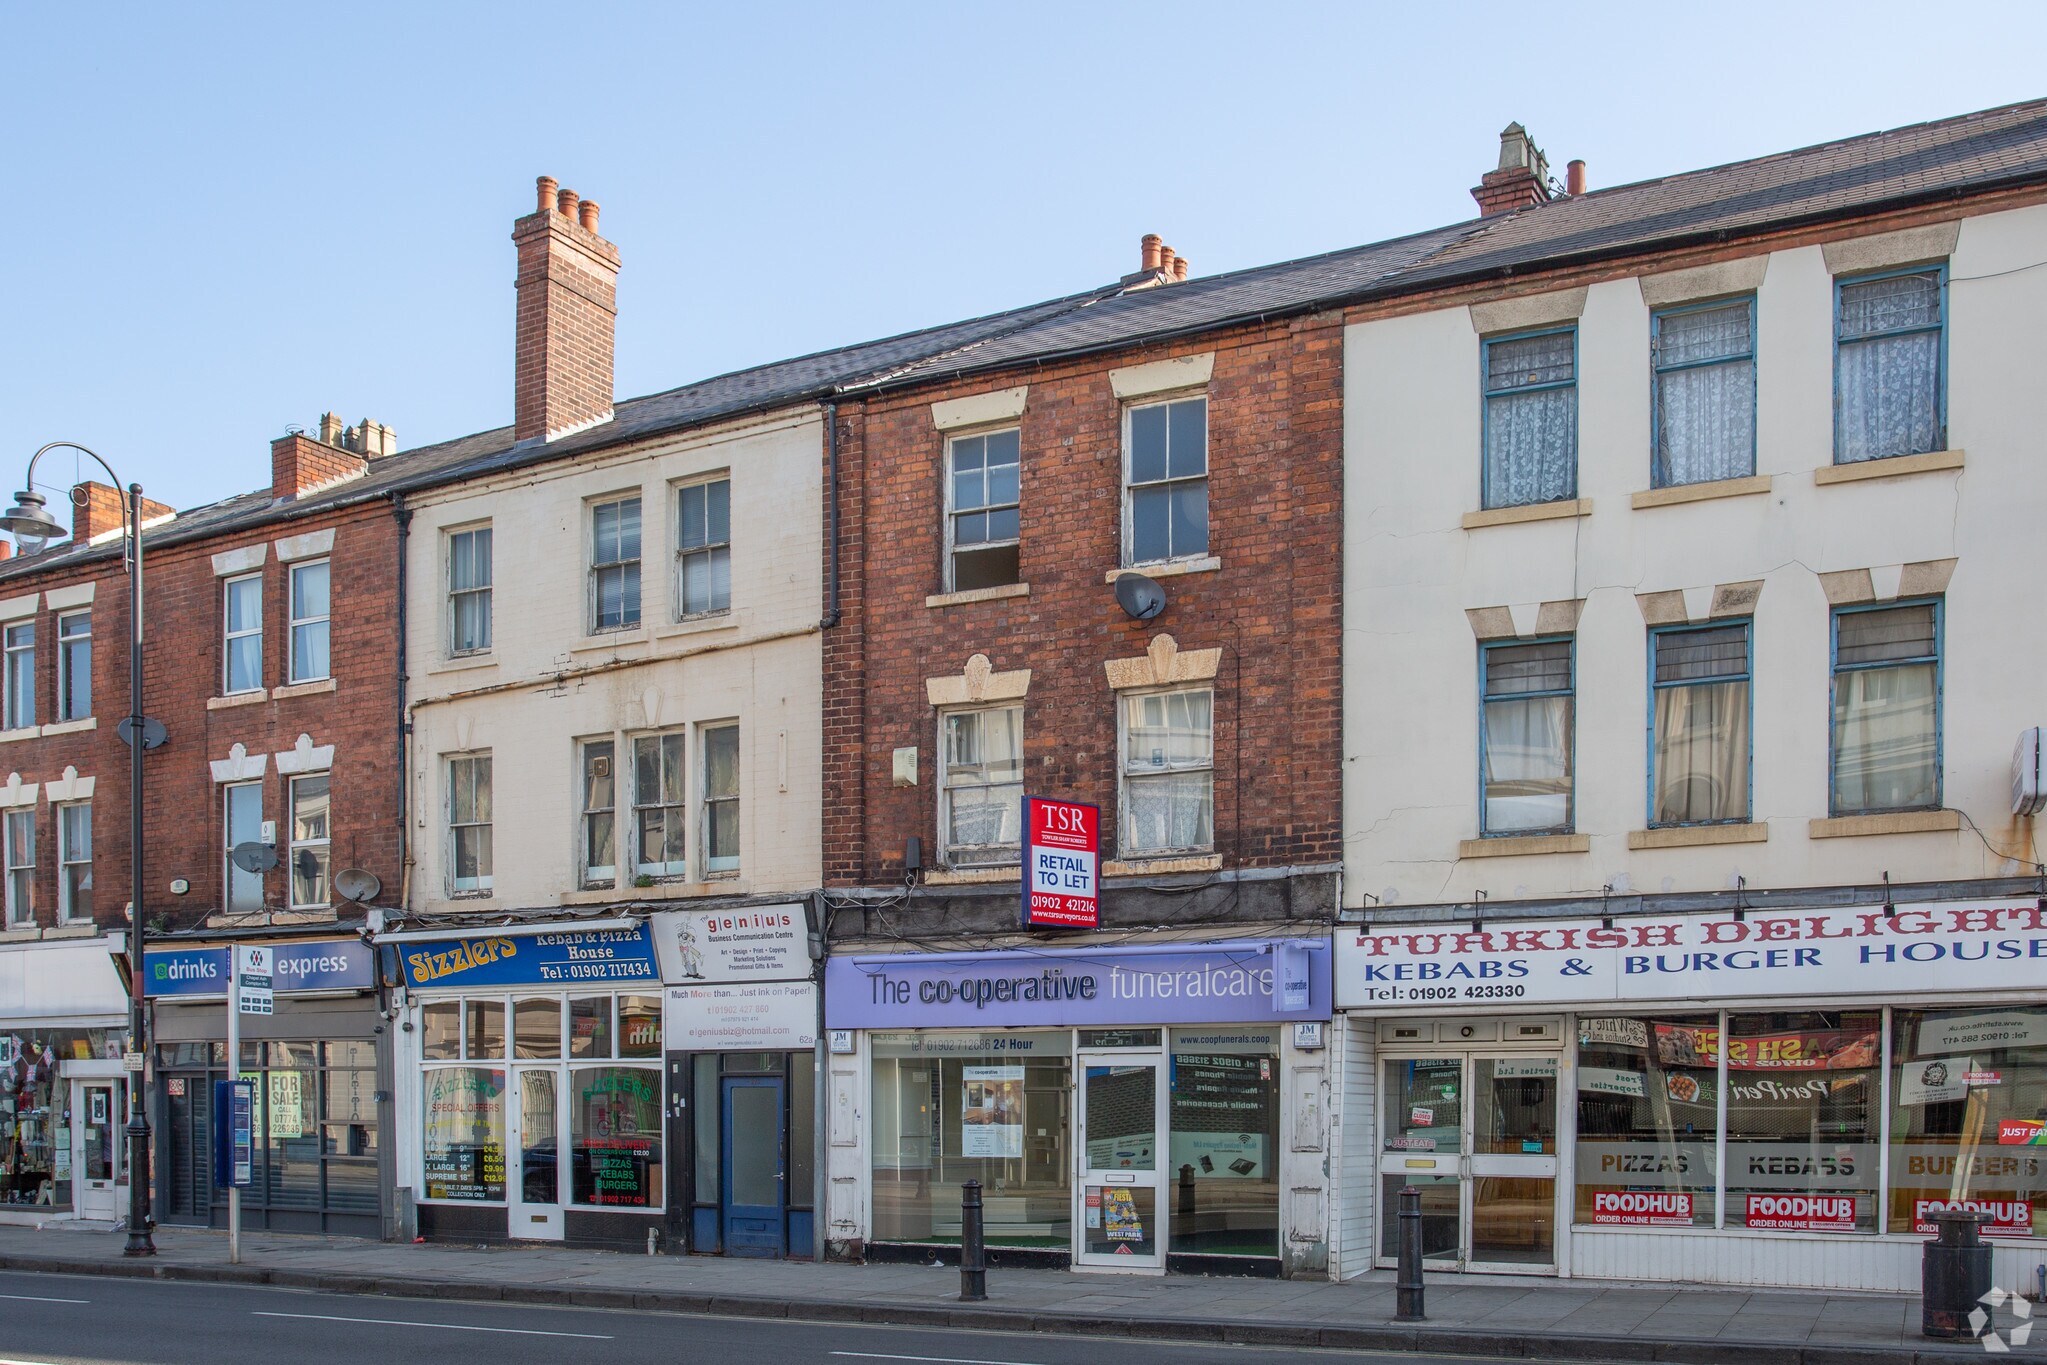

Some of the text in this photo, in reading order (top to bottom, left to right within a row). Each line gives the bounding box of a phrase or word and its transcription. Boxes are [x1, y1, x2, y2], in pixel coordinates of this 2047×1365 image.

[1041, 804, 1087, 833] TSR
[1040, 854, 1087, 873] RETAIL
[1038, 871, 1090, 889] TO LET
[1031, 895, 1095, 912] 01902 421216
[1032, 910, 1096, 922] www.tsrsurveyors.co.uk
[537, 930, 642, 946] Kebab & Pizza
[708, 934, 732, 943] Business
[732, 933, 775, 942] Communication
[1356, 907, 2047, 957] TURKISH DELIGHT
[567, 946, 614, 959] House
[769, 946, 787, 954] Copying
[408, 938, 517, 983] Sizzlers
[1364, 939, 2047, 981] KEBABS & BURGER HOUSE
[168, 958, 217, 980] drinks
[278, 955, 348, 979] express
[570, 964, 607, 978] 01902
[608, 962, 652, 976] 717434
[671, 990, 689, 999] Much
[690, 990, 711, 998] More
[739, 989, 756, 997] Just
[785, 986, 810, 996] Paper!
[867, 963, 1273, 1010] The co-operative funeralcare
[1285, 981, 1307, 993] co-operative
[1364, 984, 1525, 1000] Tel: 01902 423330
[739, 1005, 752, 1014] 427
[755, 1005, 769, 1013] 860
[1300, 1025, 1315, 1035] JM
[799, 1035, 813, 1044] 62a
[835, 1032, 847, 1042] JM
[1180, 1034, 1270, 1045] www.coopfunerals.coop
[927, 1039, 955, 1051] 01902
[957, 1039, 990, 1050] 712686
[993, 1039, 1006, 1050] 24
[1010, 1038, 1034, 1049] Hour
[271, 1076, 298, 1091] FOR
[582, 1076, 652, 1102] SIZZLERS
[272, 1092, 299, 1105] SALE
[431, 1103, 500, 1113] SPECIAL OFFERS
[274, 1114, 297, 1123] 07774
[2002, 1128, 2028, 1137] JUST
[607, 1139, 652, 1150] DELIVERY
[1394, 1139, 1428, 1147] JUST EAT
[484, 1155, 504, 1163] £6.50
[602, 1158, 632, 1169] PIZZAS
[1601, 1154, 1688, 1173] PIZZAS
[484, 1165, 504, 1173] £9.99
[1749, 1156, 1855, 1176] KEBABS
[600, 1169, 635, 1179] KEBABS
[596, 1180, 638, 1190] BURGERS
[620, 1195, 632, 1203] 717
[1595, 1193, 1690, 1213] FOODHUB
[1749, 1196, 1852, 1218] FOODHUB
[1595, 1215, 1649, 1224] ORDER ONLINE
[1749, 1219, 1777, 1228] ORDER
[1777, 1220, 1807, 1229] ONLINE
